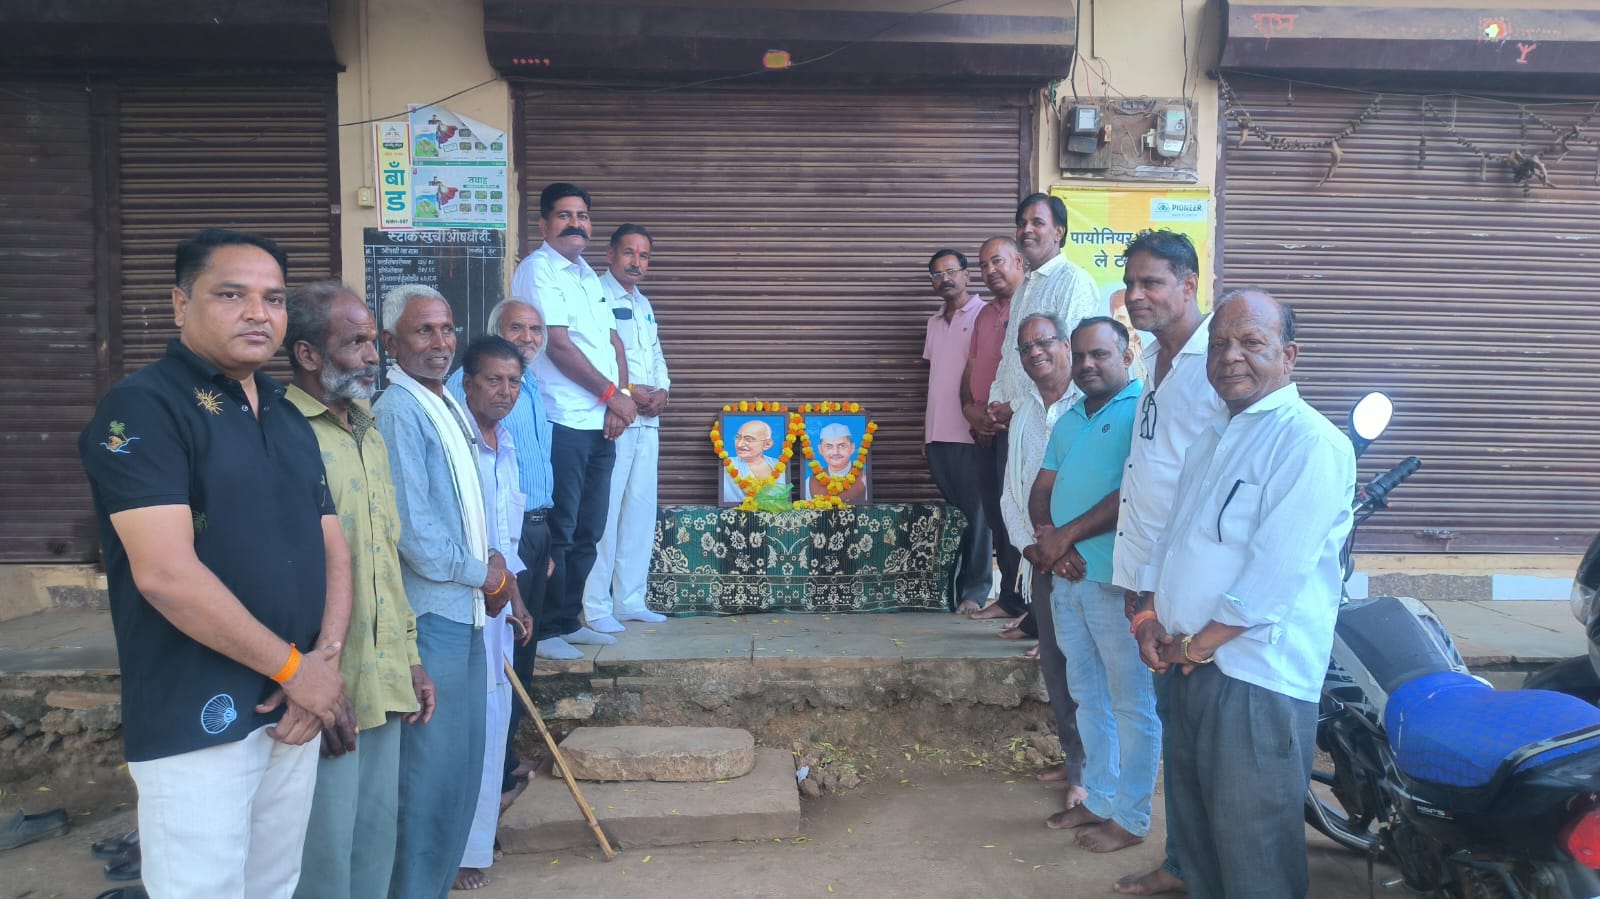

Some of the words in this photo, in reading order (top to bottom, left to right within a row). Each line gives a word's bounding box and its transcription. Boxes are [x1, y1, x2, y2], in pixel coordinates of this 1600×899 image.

[1171, 203, 1203, 212] PIONEER
[1070, 228, 1133, 245] पायोनियर
[1094, 250, 1108, 268] ले
